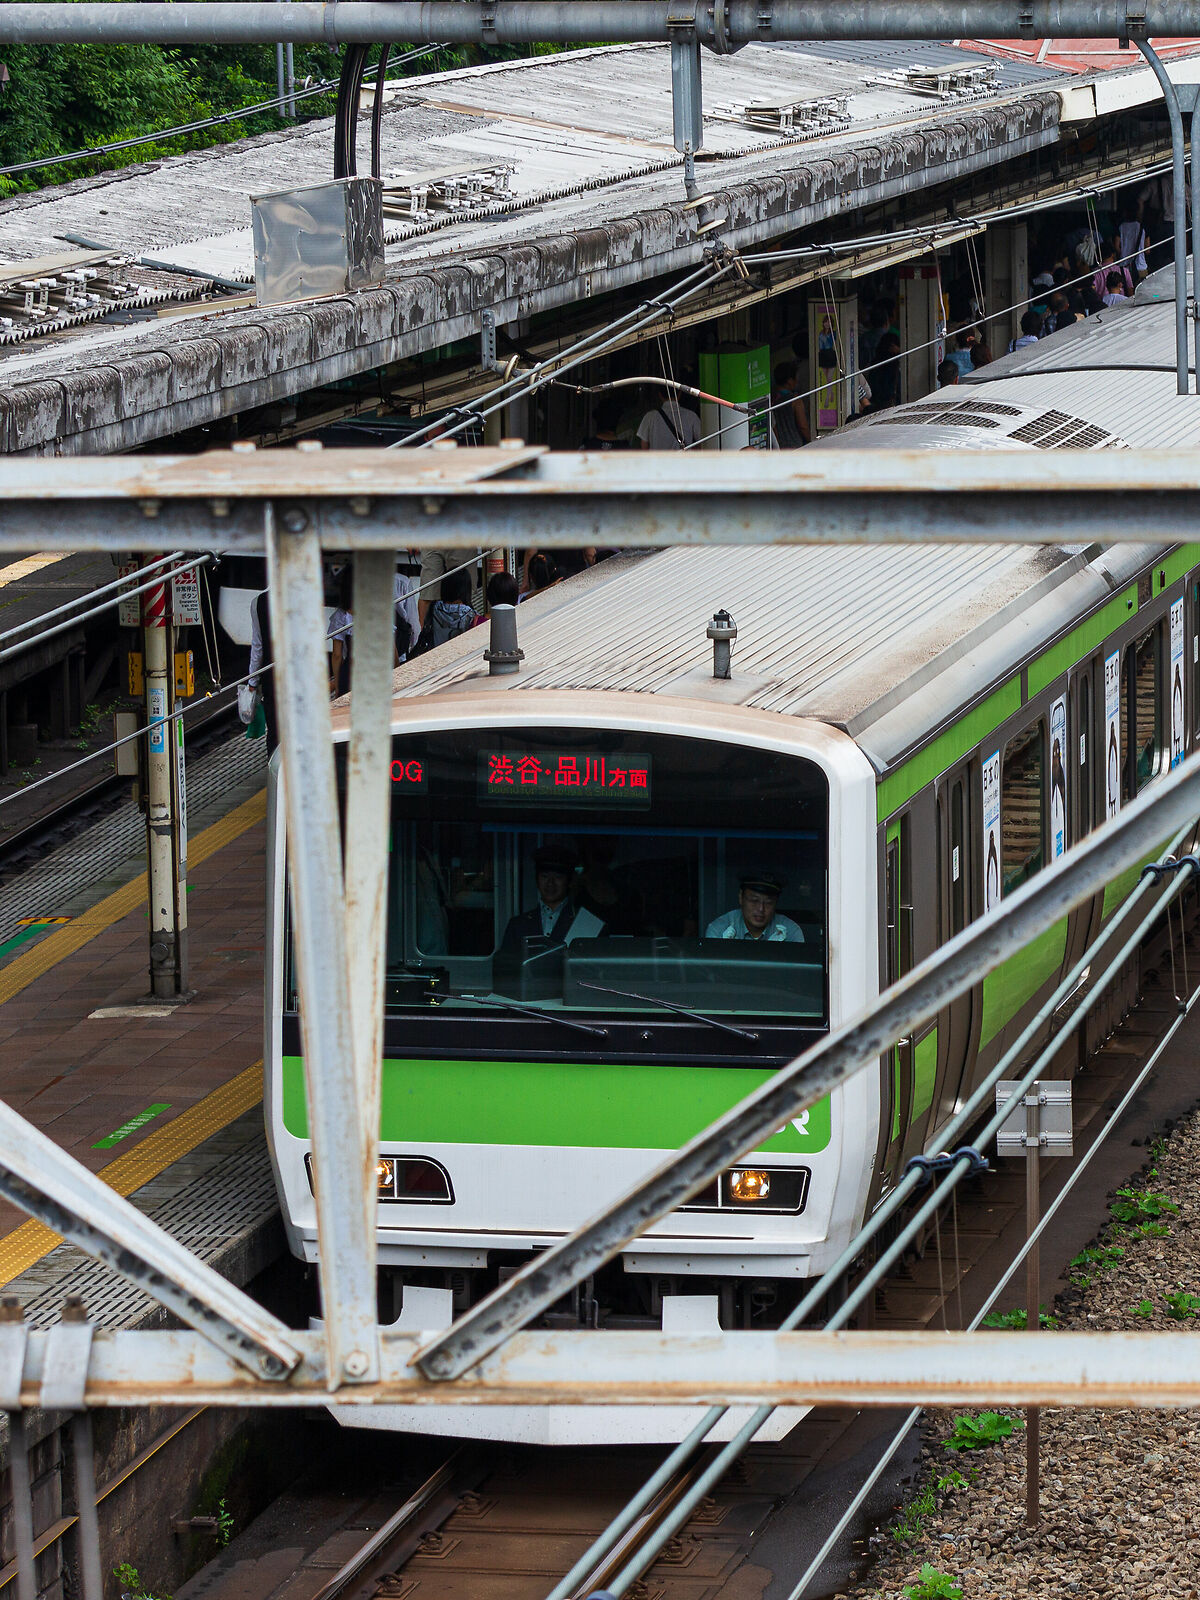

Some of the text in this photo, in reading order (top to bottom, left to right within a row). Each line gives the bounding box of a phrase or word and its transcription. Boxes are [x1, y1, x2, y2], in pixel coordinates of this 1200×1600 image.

[488, 754, 648, 787] 渋谷・品川方面
[984, 760, 998, 791] 日本の
